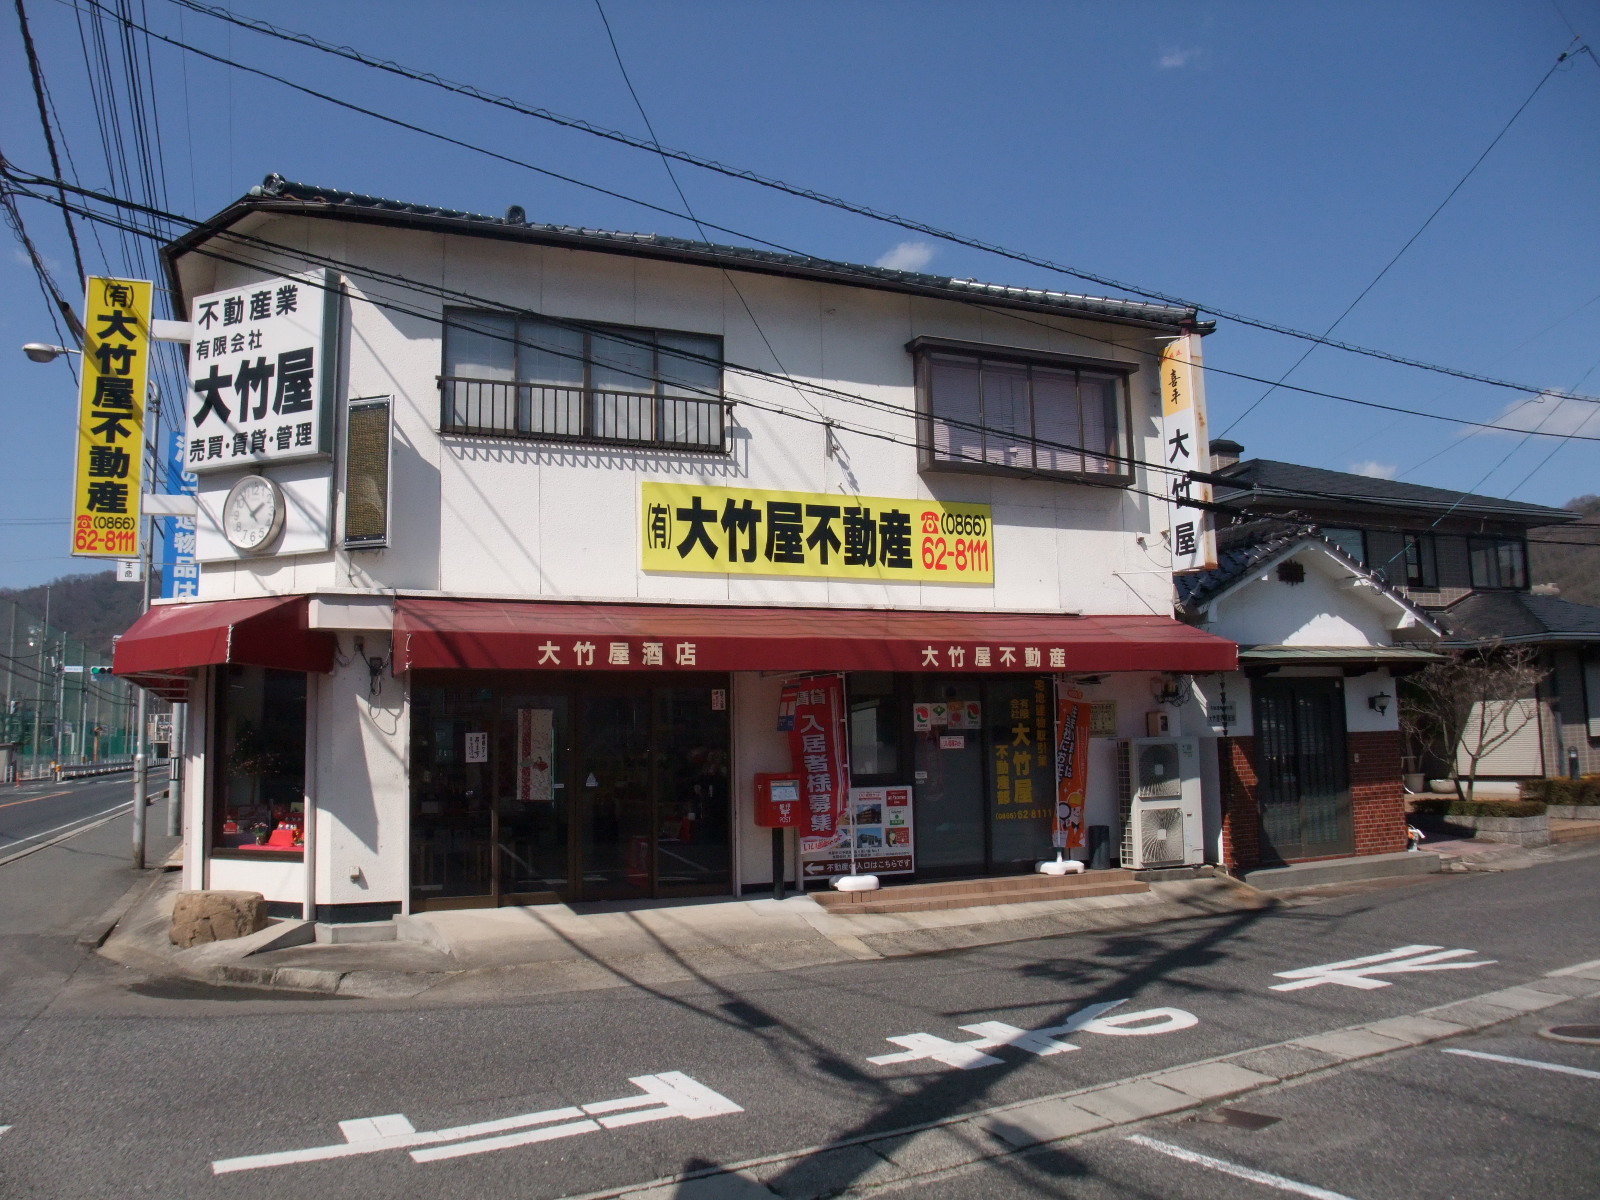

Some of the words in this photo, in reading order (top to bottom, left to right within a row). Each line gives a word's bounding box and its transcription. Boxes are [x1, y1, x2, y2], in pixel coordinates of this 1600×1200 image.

[198, 284, 299, 331] 不動産業
[196, 329, 263, 361] 有限会社
[192, 346, 314, 429] 大竹屋
[1168, 428, 1197, 557] 大竹屋
[75, 528, 136, 551] 62-8111
[93, 516, 136, 530] (0866)
[940, 512, 987, 537] (0866)
[921, 537, 989, 572] 62-8111
[538, 640, 697, 667] 大竹屋酒店
[921, 646, 1066, 668] 大竹屋不動産
[800, 714, 832, 832] 入居者様募集
[1012, 722, 1033, 803] 大竹屋
